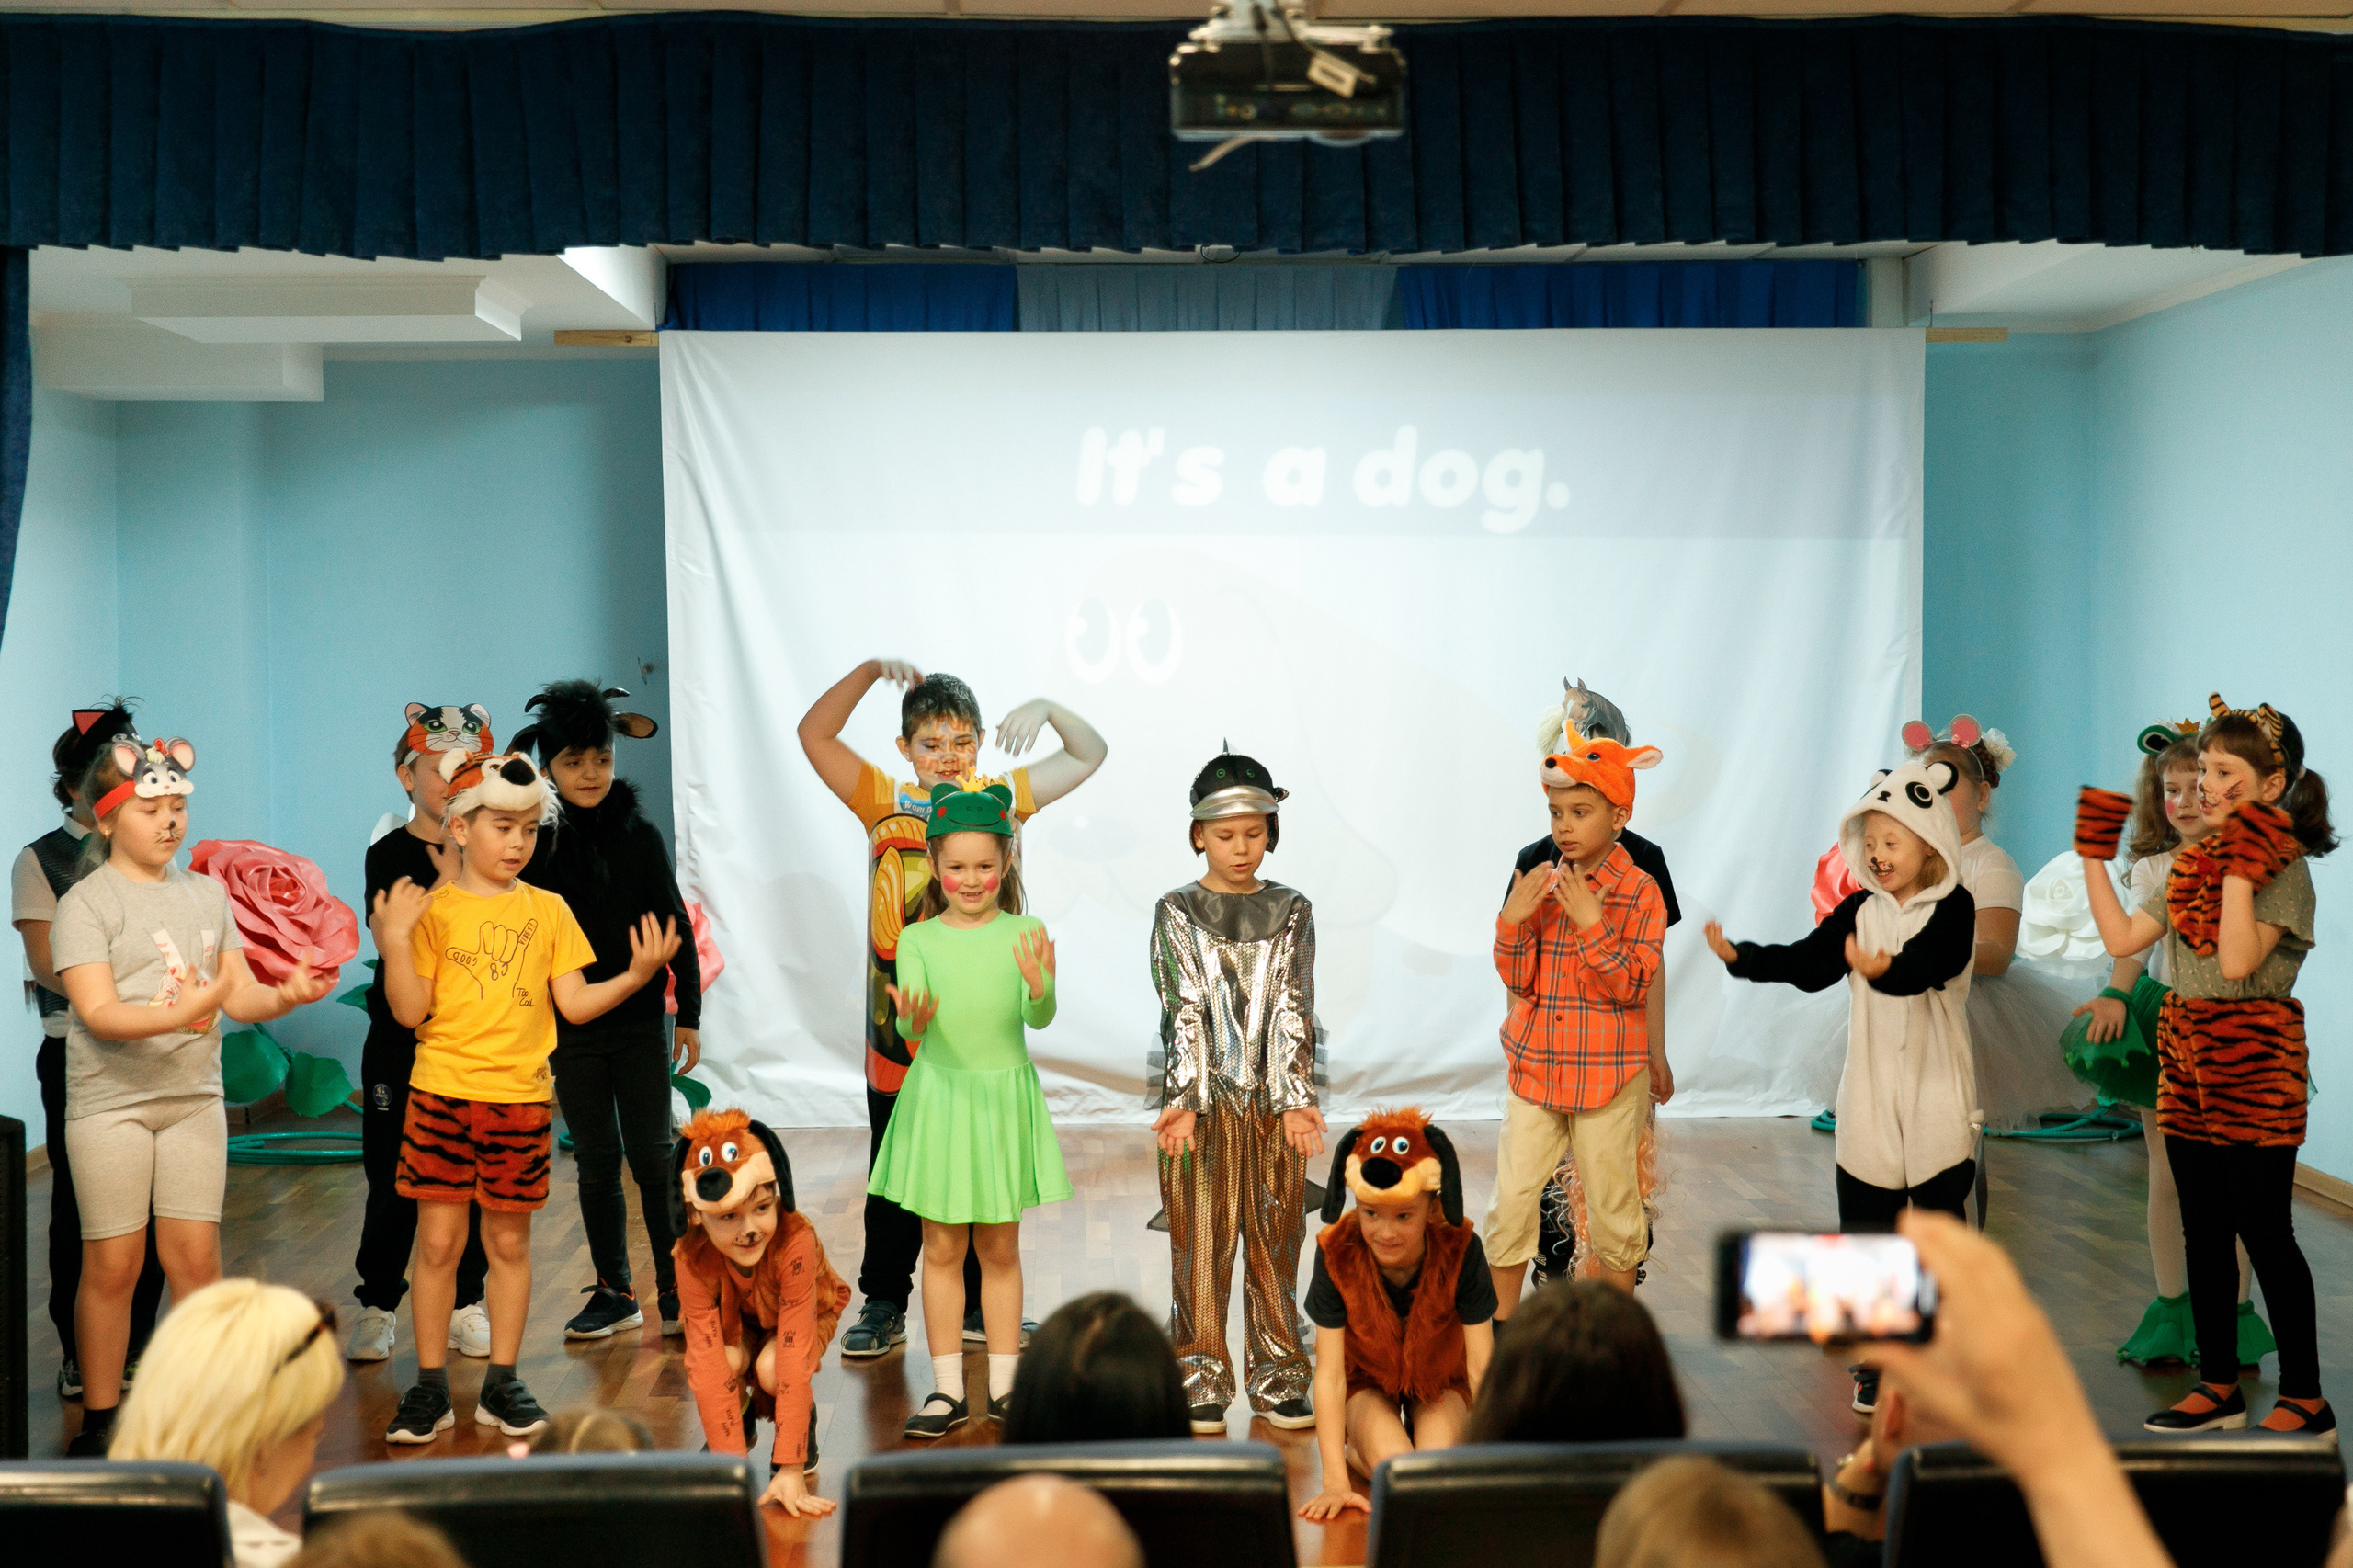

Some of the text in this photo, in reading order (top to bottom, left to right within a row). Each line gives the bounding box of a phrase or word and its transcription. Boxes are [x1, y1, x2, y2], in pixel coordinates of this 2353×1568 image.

[1076, 424, 1570, 534] It's a dog.
